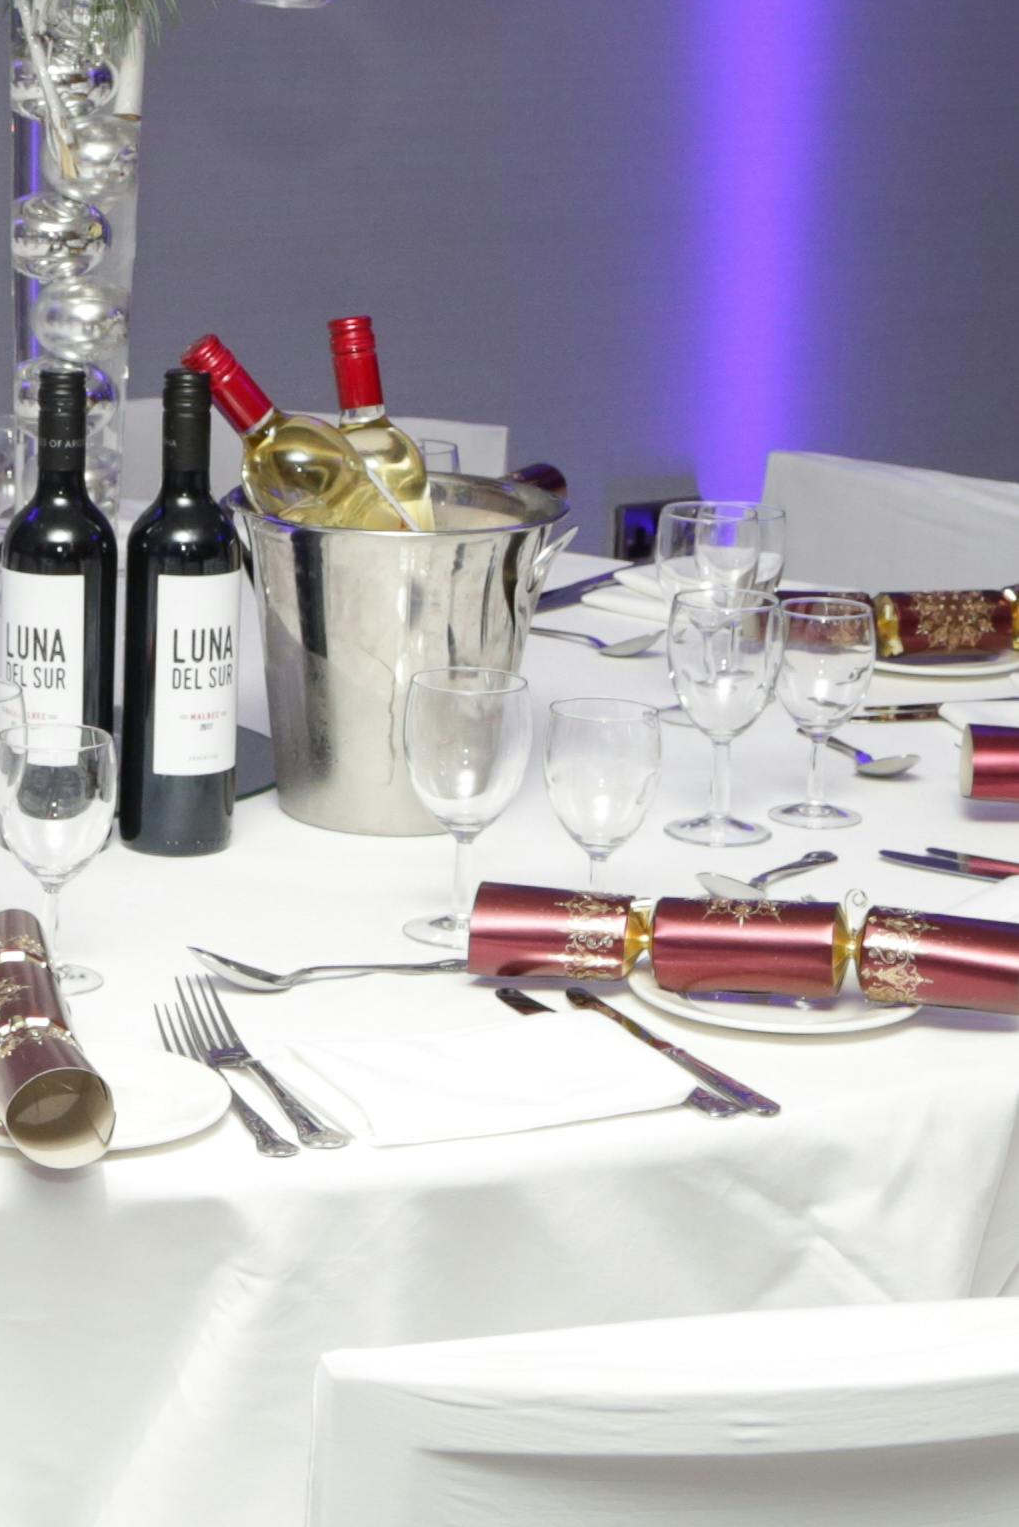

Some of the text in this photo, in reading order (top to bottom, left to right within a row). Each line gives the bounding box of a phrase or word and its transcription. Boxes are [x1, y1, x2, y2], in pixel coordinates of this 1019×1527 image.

[6, 621, 66, 663] LUNA
[173, 625, 233, 664] LUNA
[6, 662, 66, 690] DEL SUR
[172, 663, 233, 690] DEL SUR
